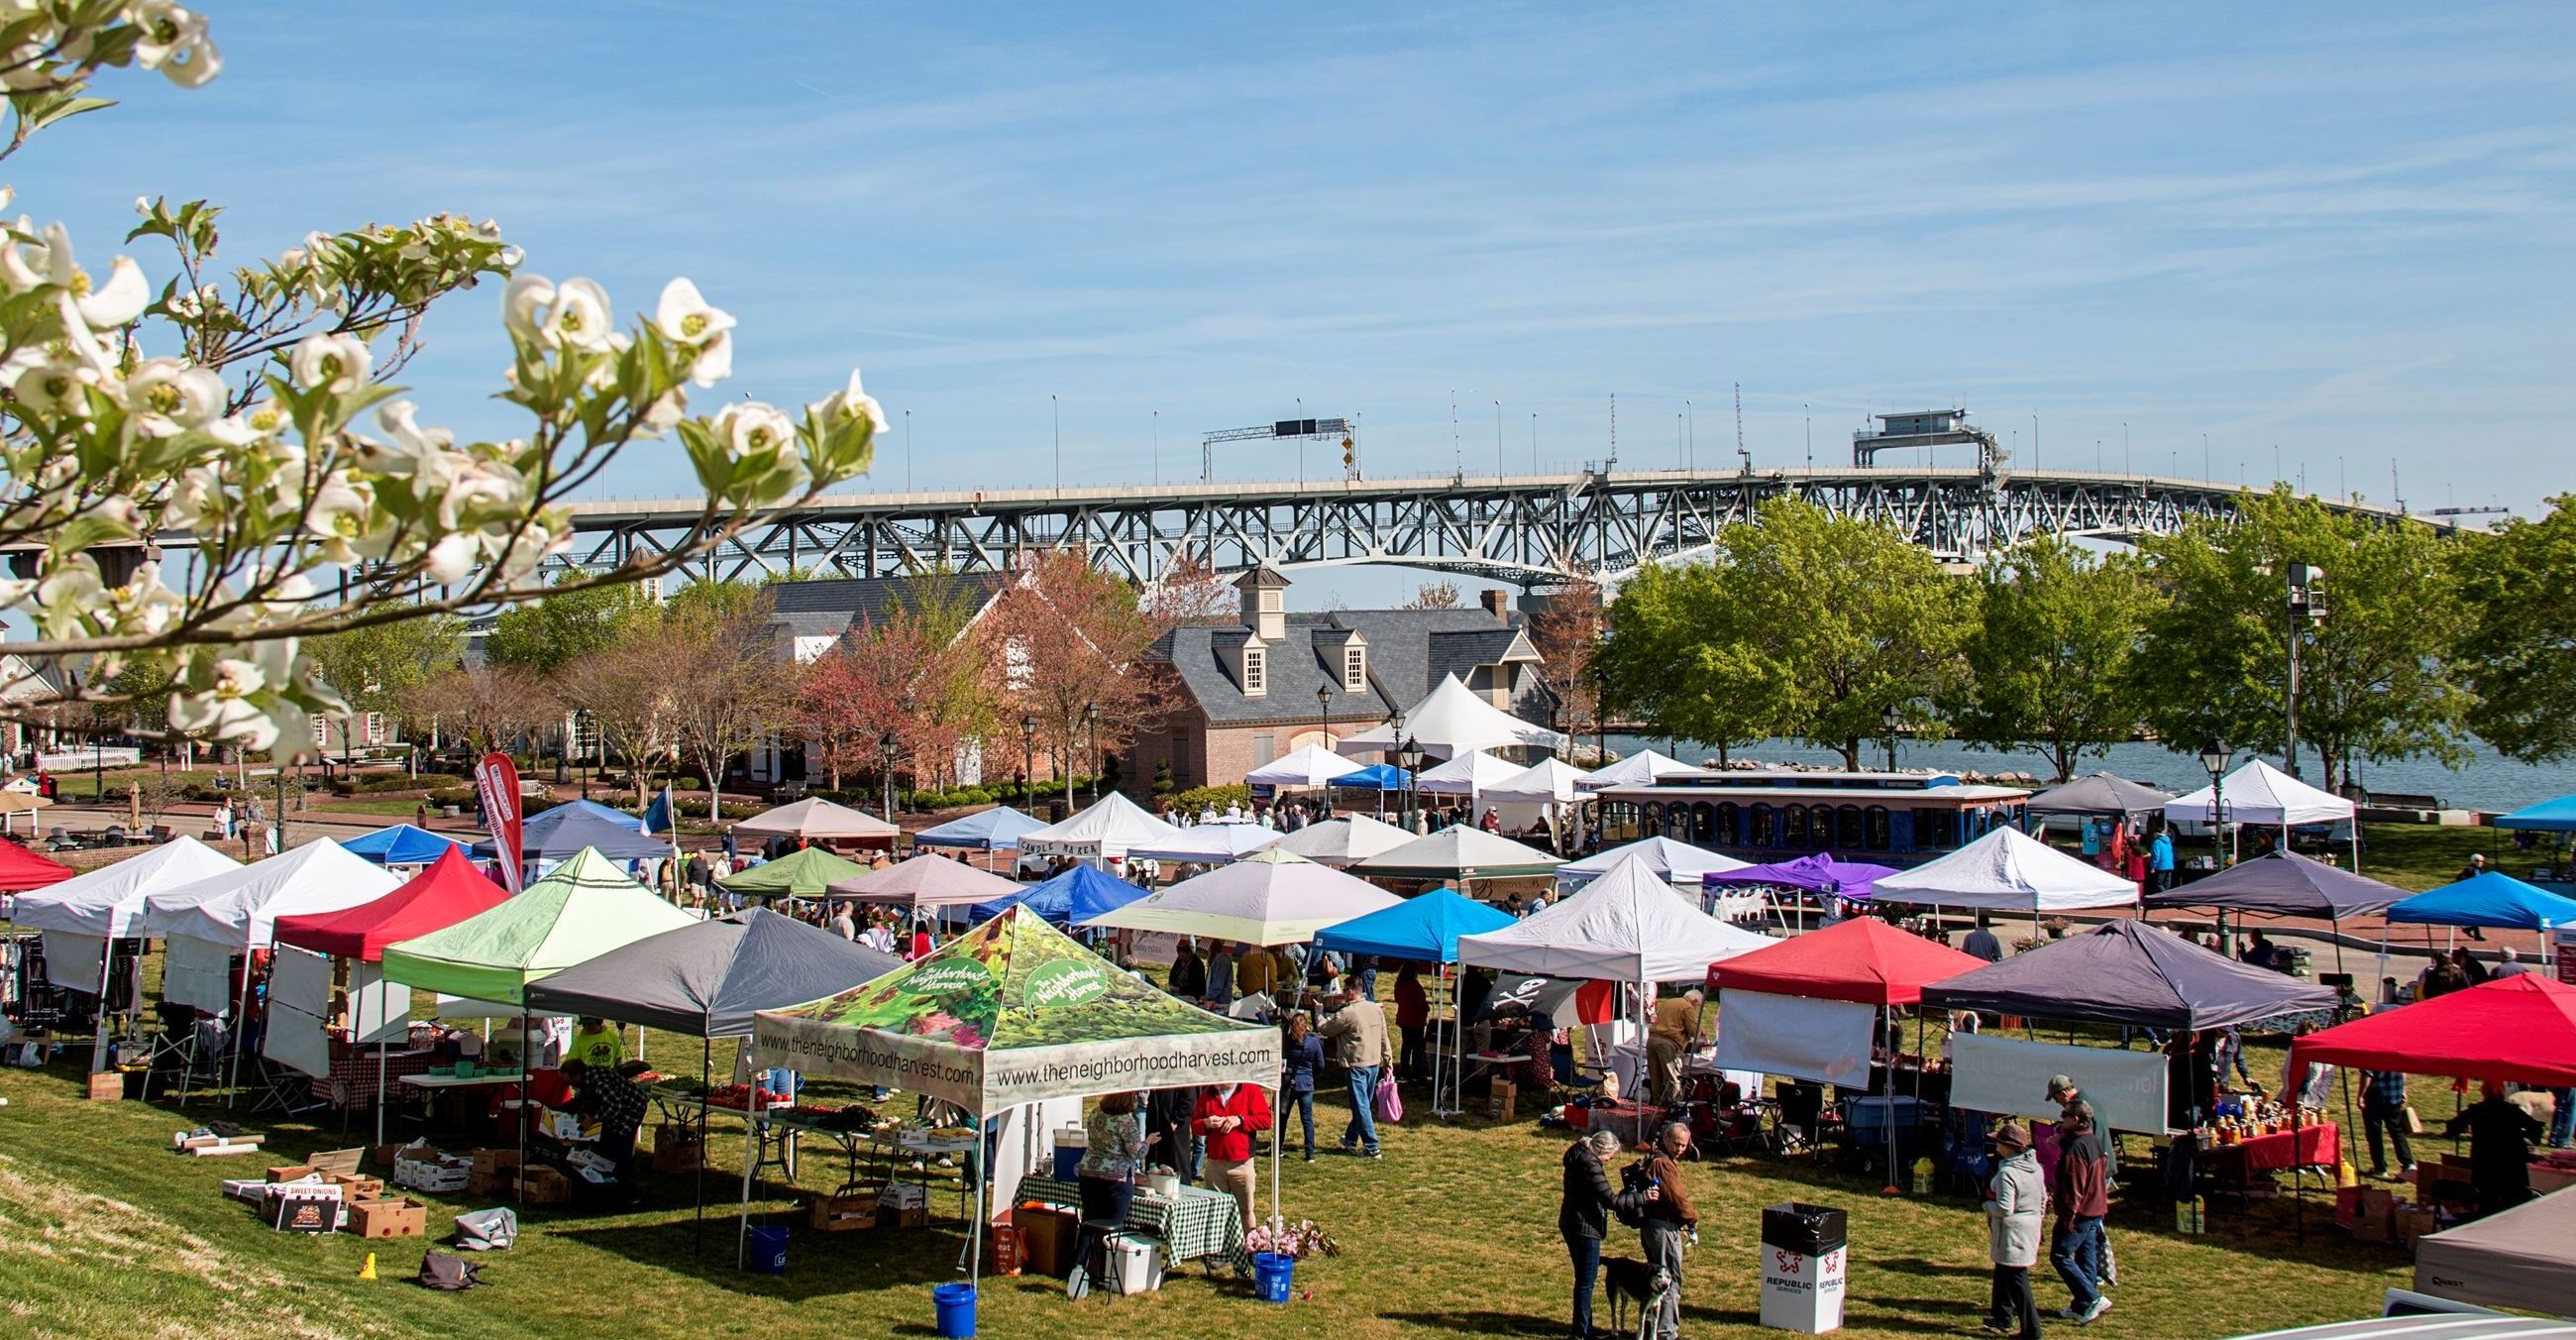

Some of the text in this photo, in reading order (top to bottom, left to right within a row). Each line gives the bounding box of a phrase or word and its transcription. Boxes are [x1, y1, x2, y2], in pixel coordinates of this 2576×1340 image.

[1020, 840, 1097, 855] CANDLE MAKER
[1035, 965, 1102, 1004] Neighborhood
[1066, 980, 1103, 1001] Harvest
[761, 1033, 974, 1085] www.theneighborhoodharvest.com
[997, 1049, 1270, 1086] www.theneighborhoodharvest.com
[290, 1186, 311, 1195] SWEET
[1767, 1277, 1812, 1289] REPUBLIC
[1819, 1278, 1843, 1288] REPUBLIC
